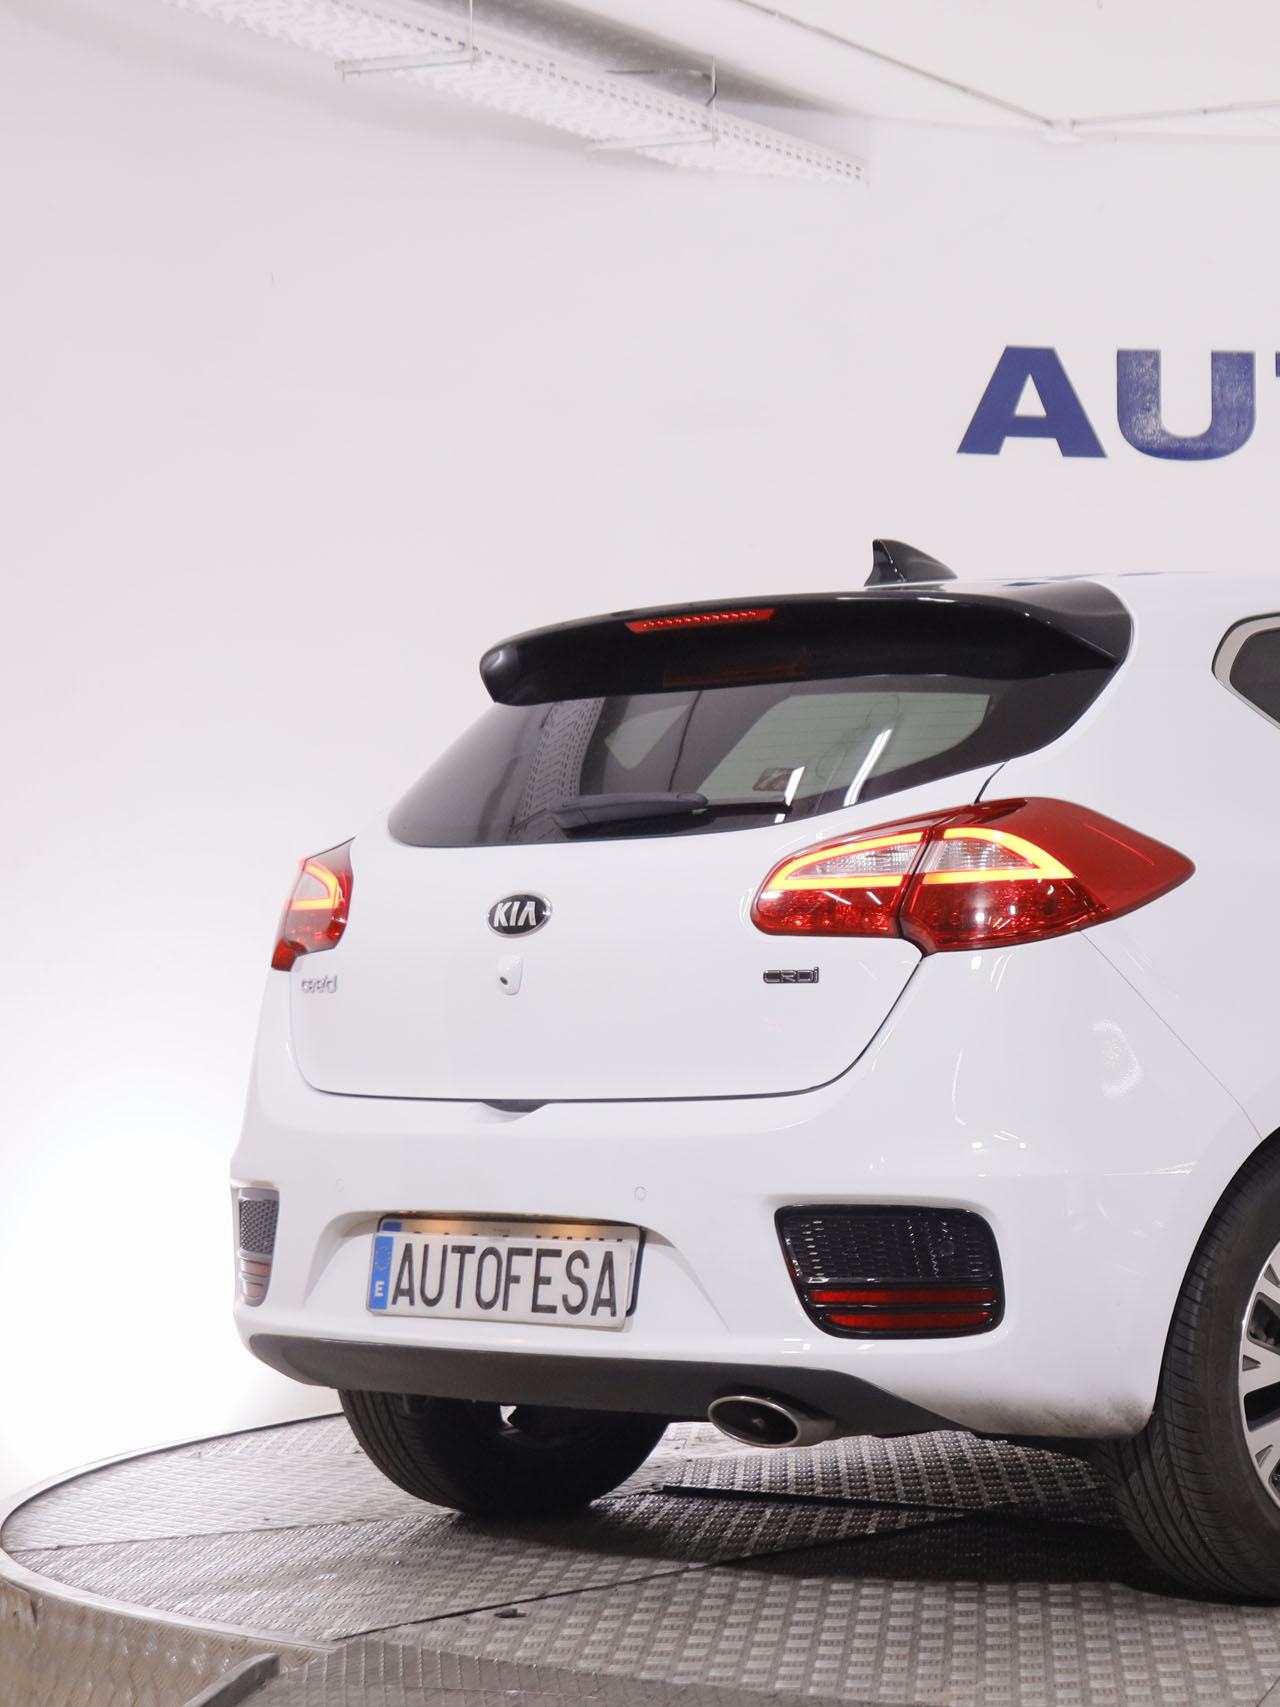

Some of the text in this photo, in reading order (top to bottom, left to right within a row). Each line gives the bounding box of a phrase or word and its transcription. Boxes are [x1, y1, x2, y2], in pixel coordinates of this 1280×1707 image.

[493, 900, 537, 928] KIA
[374, 1281, 384, 1297] E
[391, 1242, 617, 1317] AUTOFESA
